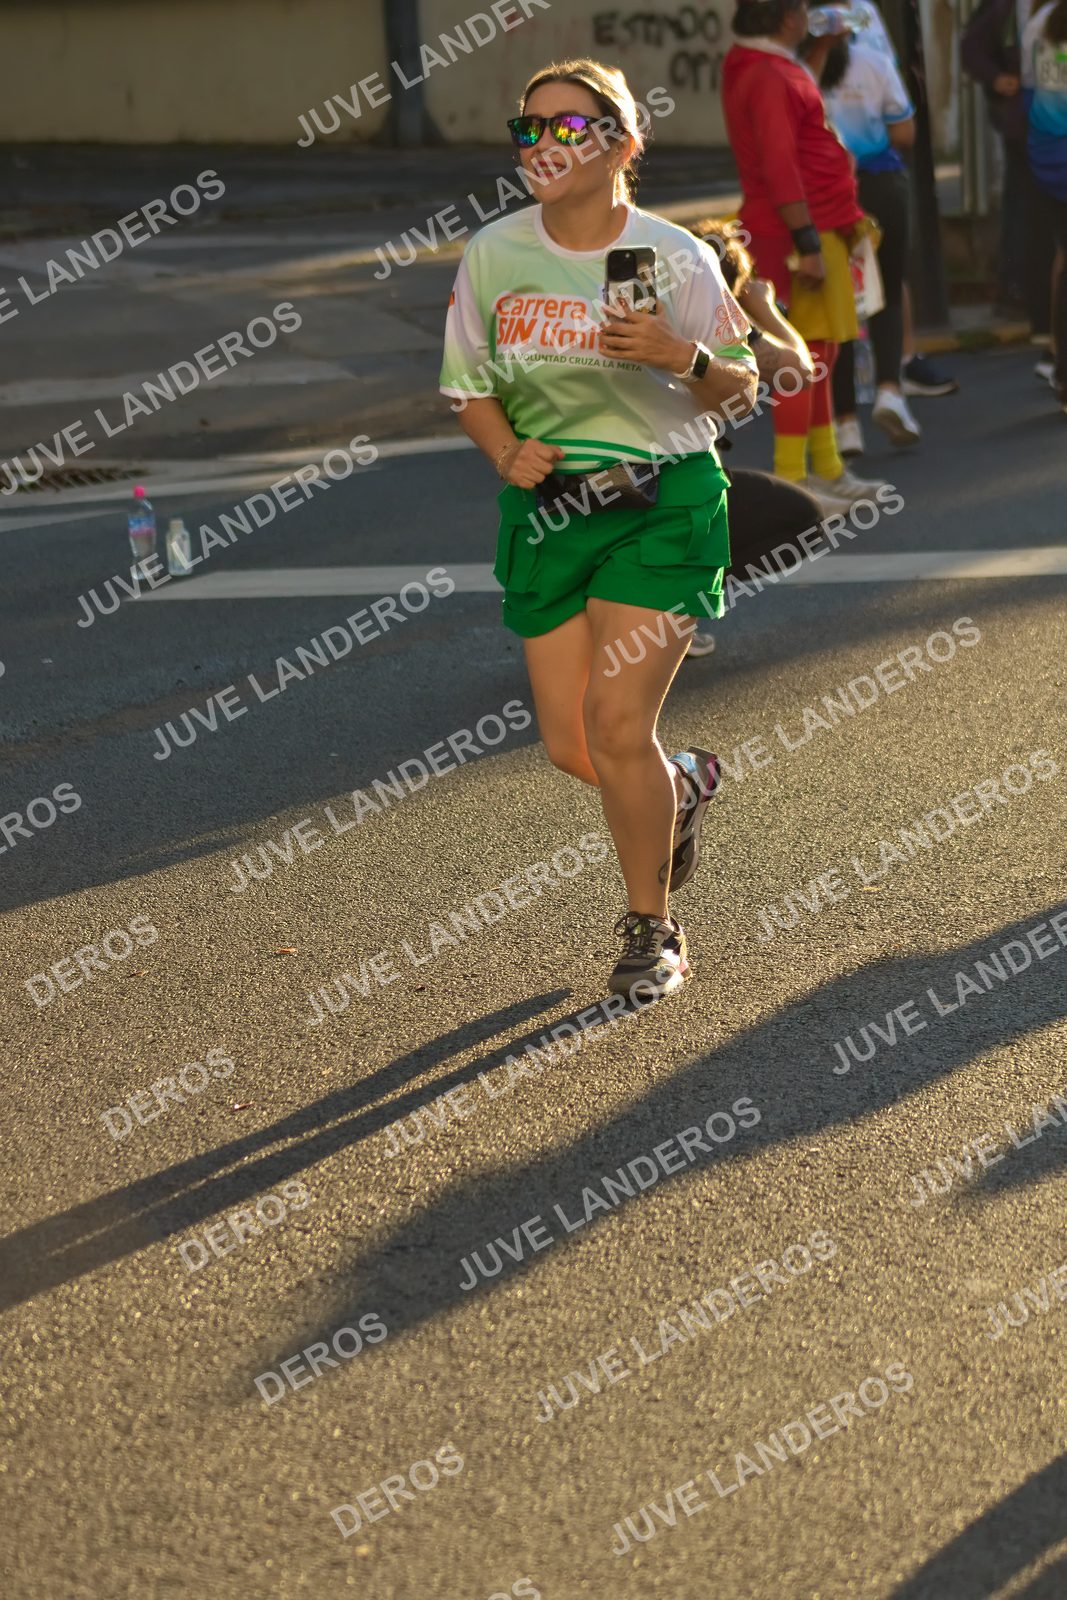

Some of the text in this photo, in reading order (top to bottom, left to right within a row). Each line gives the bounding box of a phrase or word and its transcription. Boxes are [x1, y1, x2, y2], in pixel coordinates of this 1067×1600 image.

[496, 295, 586, 320] Carrera
[496, 317, 538, 346] SIN
[569, 356, 600, 367] CRUZA
[602, 360, 614, 368] LA
[617, 362, 642, 372] META
